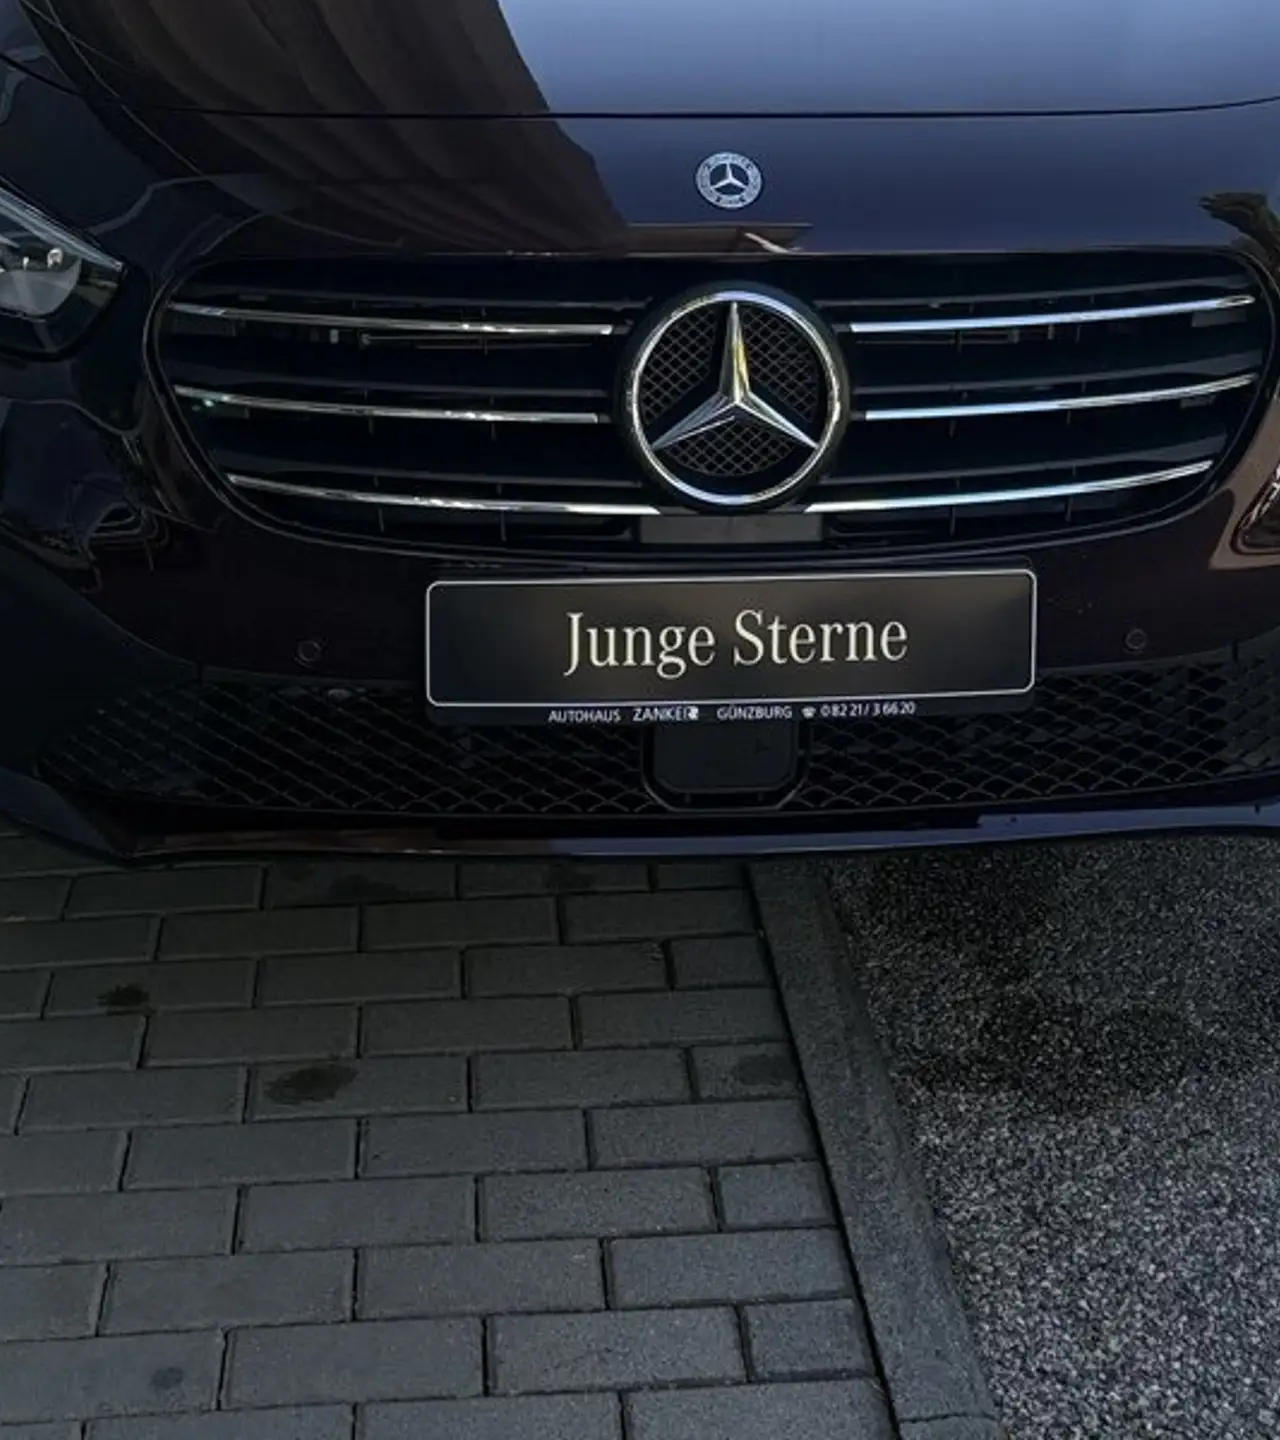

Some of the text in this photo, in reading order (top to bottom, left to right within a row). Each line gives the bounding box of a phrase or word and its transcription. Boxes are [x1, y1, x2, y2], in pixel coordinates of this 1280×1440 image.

[564, 609, 908, 679] Junge Sterne
[548, 708, 621, 723] AUTOHAUS
[717, 704, 793, 721] GÜNZBURG
